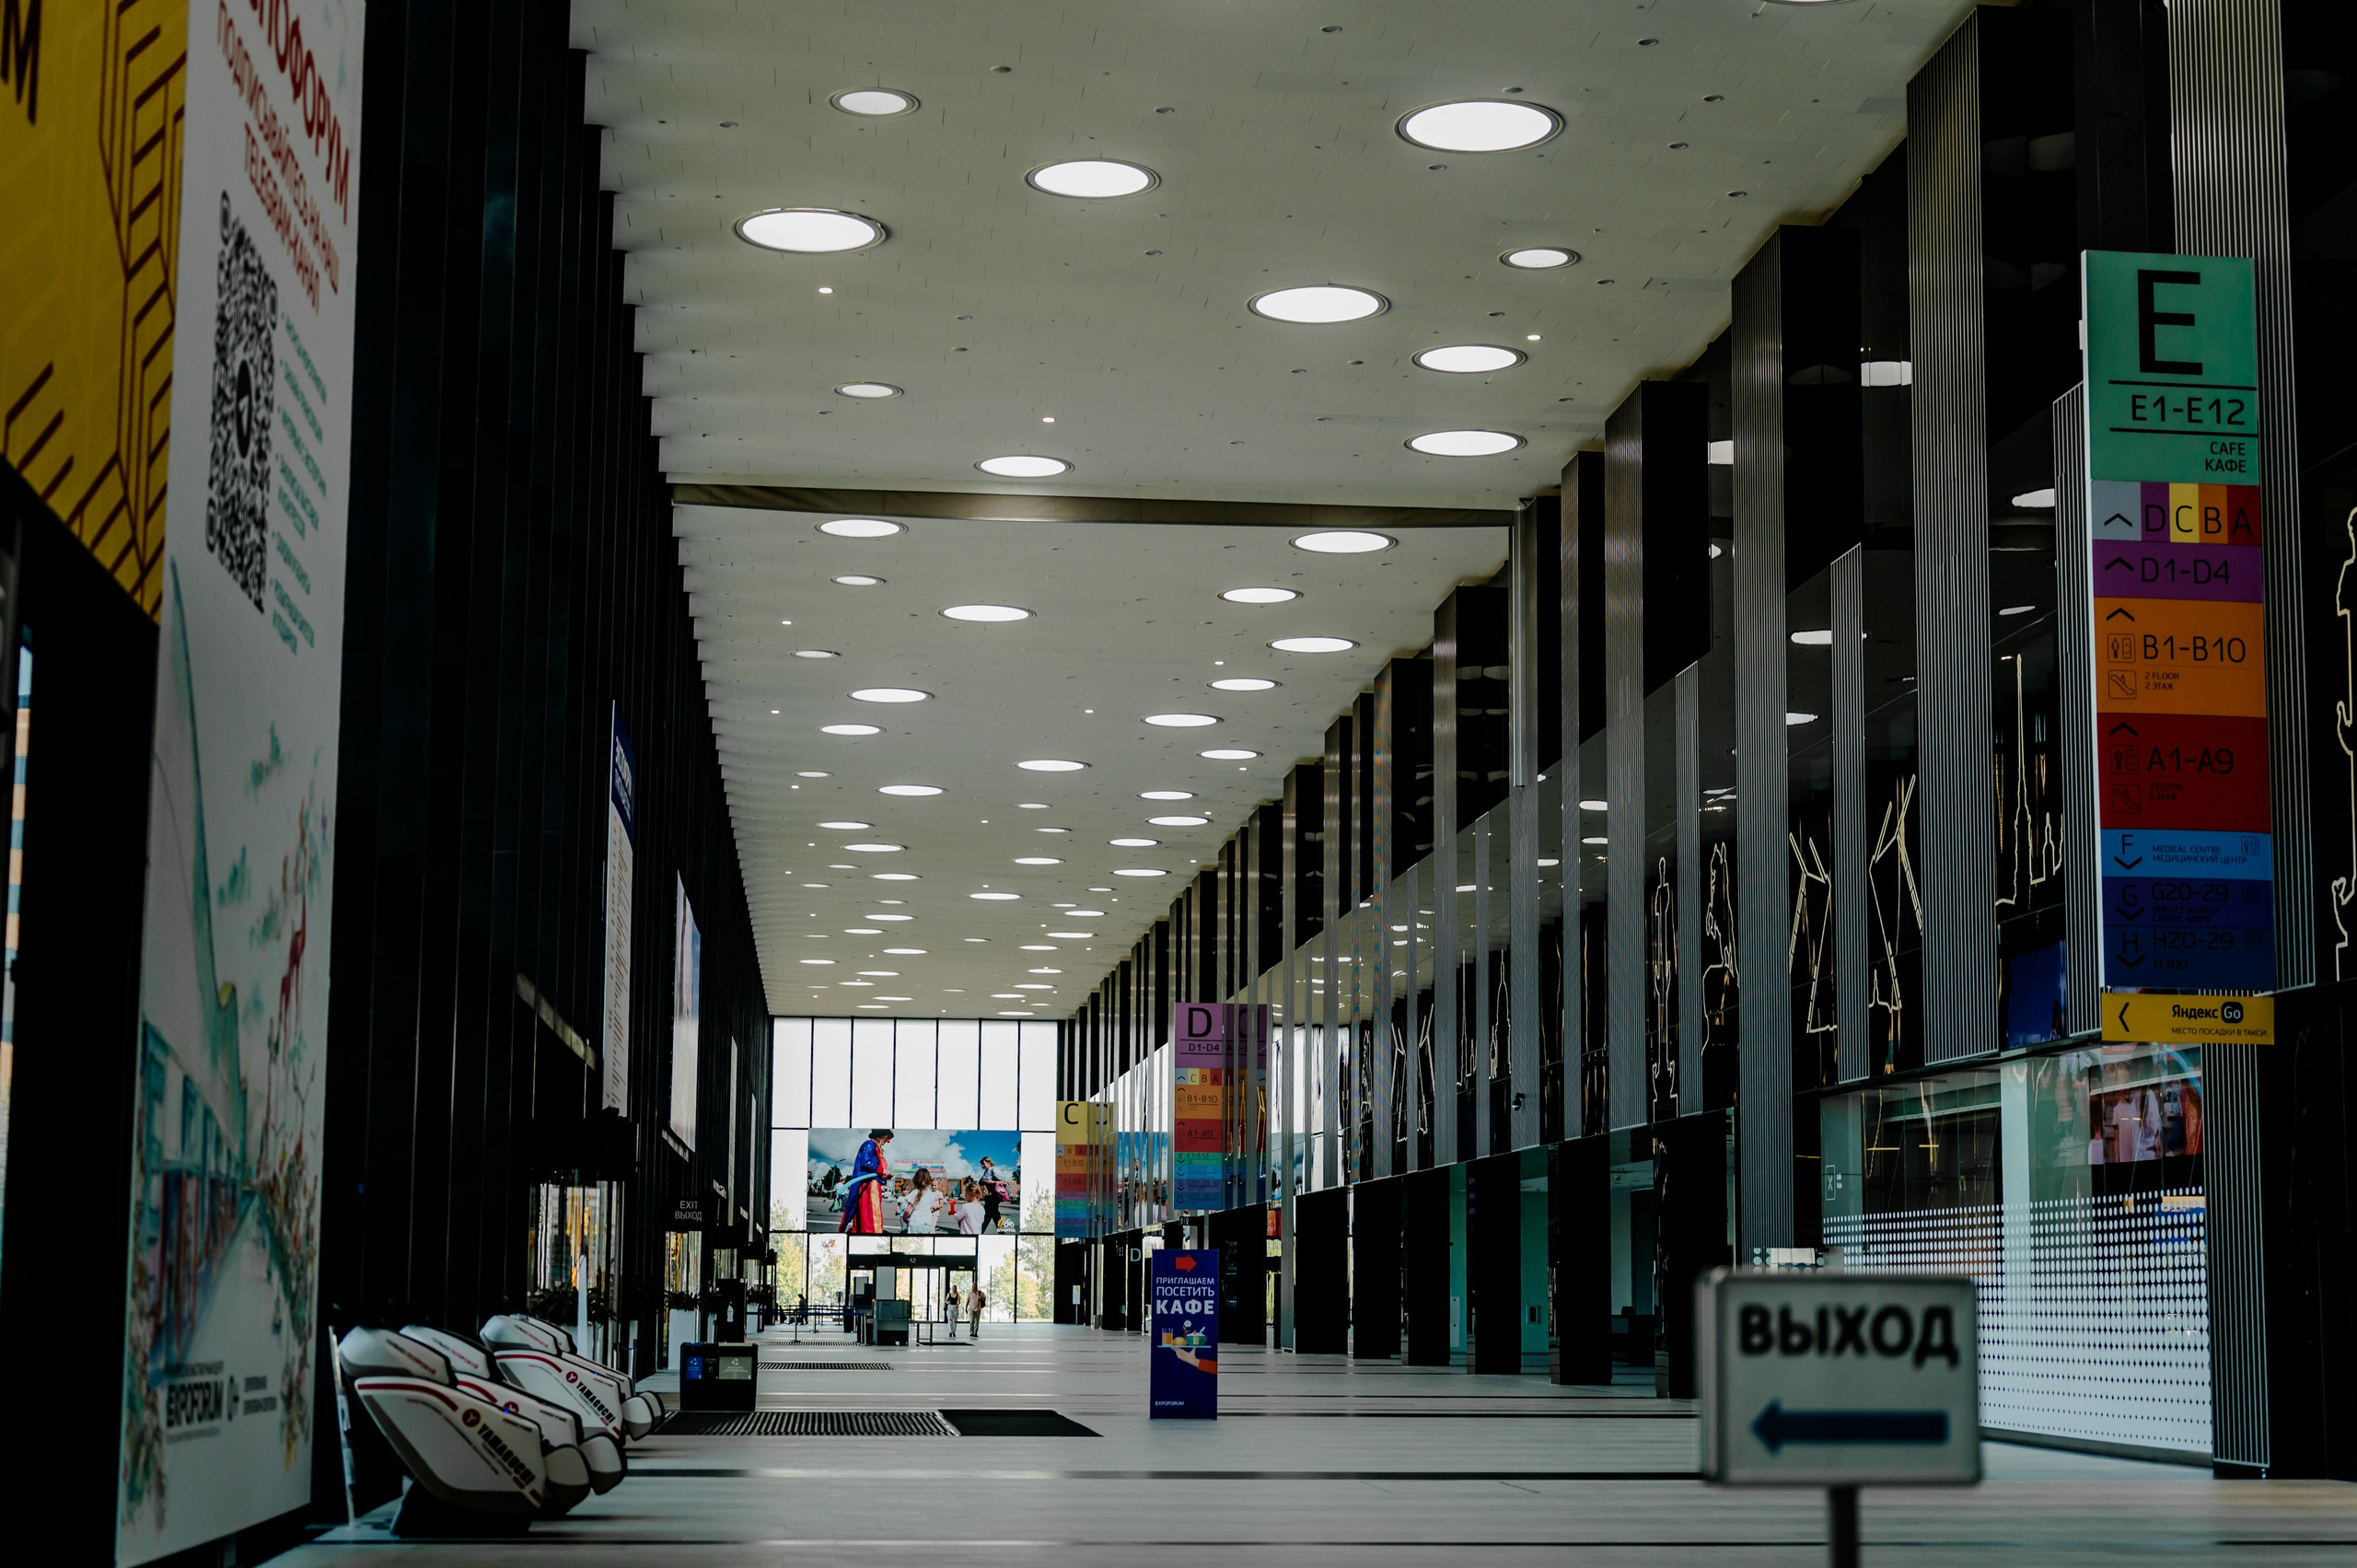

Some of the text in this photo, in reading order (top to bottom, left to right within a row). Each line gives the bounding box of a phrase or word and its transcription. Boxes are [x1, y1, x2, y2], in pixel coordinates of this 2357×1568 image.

[2137, 269, 2203, 376] E
[2131, 394, 2246, 426] E1-E12
[2210, 441, 2247, 457] CAFE
[2204, 458, 2247, 474] КАФЕ
[2144, 504, 2253, 537] D C B A
[2141, 557, 2230, 586] D1-D4
[2142, 634, 2247, 664] B1-B10
[2144, 671, 2179, 680] 2 FLOOR
[2144, 681, 2174, 691] 2 ЭТАЖ
[2147, 746, 2235, 774] A1-A9
[2121, 834, 2134, 855] F
[2152, 844, 2221, 854] MEDICAL CENTRE
[2152, 854, 2247, 865] МЕДИЦИНСКИЙ ЦЕНТР
[2122, 884, 2138, 907] G
[2151, 882, 2229, 902] G20-29
[2122, 931, 2139, 954] H
[2153, 931, 2235, 950] H20-29
[2154, 958, 2189, 970] H100
[2172, 1005, 2242, 1020] Яндекс Go
[1188, 1007, 1213, 1038] D
[2171, 1028, 2198, 1036] МЕСТО
[2199, 1028, 2235, 1037] ПОСАДКИ
[2244, 1028, 2268, 1037] ТАКСИ
[1189, 1043, 1220, 1052] D1-D4
[1190, 1074, 1219, 1083] C B A
[1187, 1095, 1218, 1104] B1-B10
[1063, 1102, 1079, 1125] C
[1187, 1129, 1213, 1138] A1-A9
[679, 1200, 699, 1210] EXIT
[674, 1211, 702, 1222] ВЫХОД
[1130, 1248, 1142, 1262] D
[1155, 1277, 1215, 1285] ПРИГЛАШАЕМ
[1155, 1286, 1215, 1297] ПОСЕТИТЬ
[1155, 1299, 1215, 1315] КАФЕ
[1737, 1302, 1961, 1369] ВЫХОД
[575, 1381, 616, 1423] YAMAGUCHI
[477, 1423, 536, 1486] YAMAGUCHI
